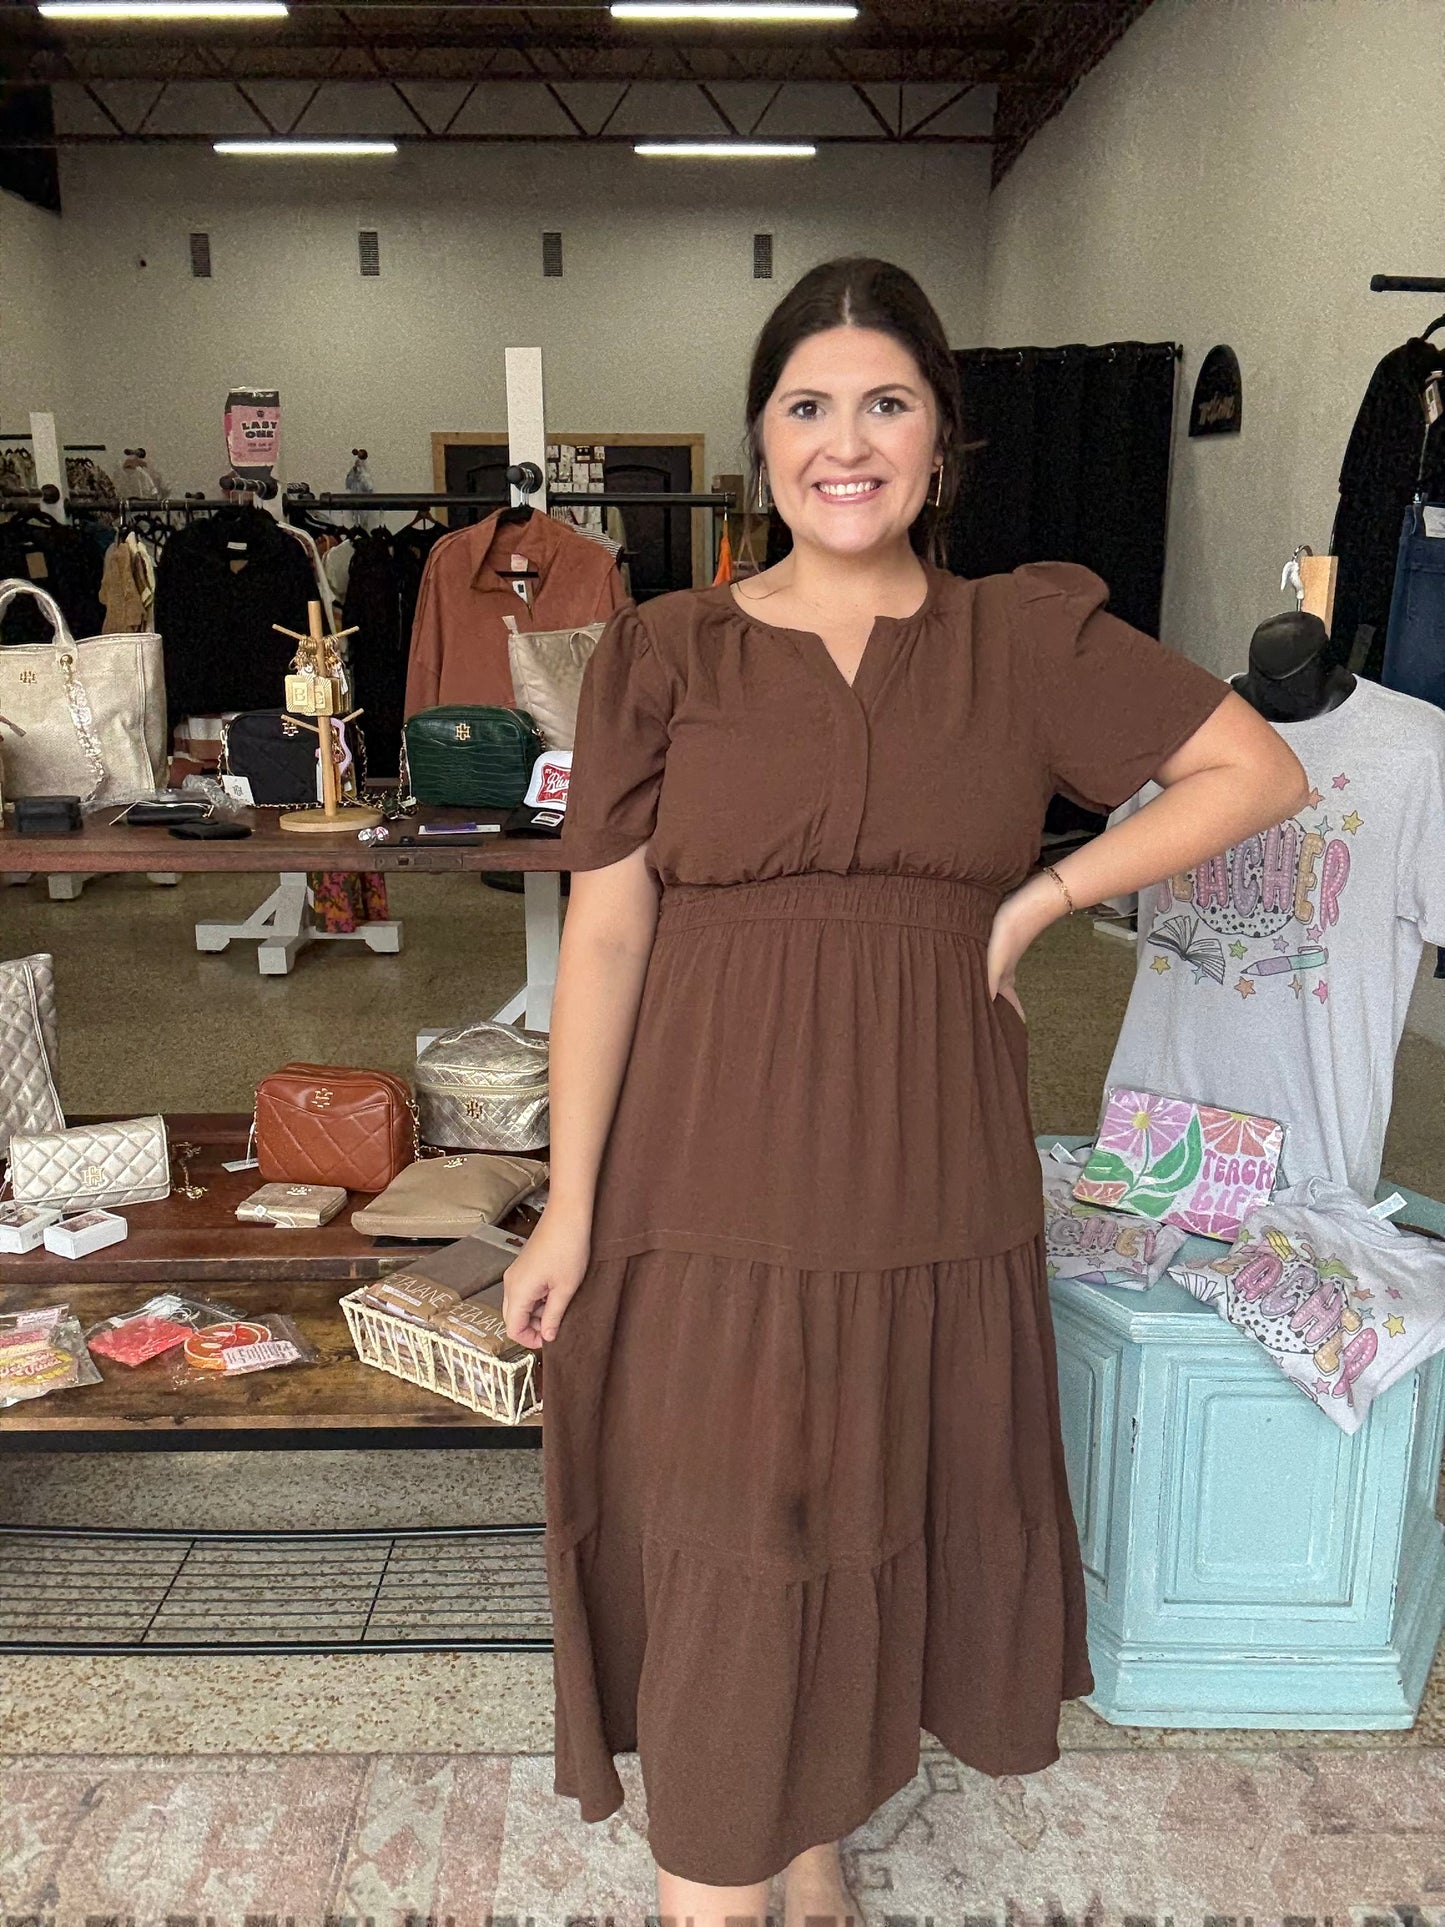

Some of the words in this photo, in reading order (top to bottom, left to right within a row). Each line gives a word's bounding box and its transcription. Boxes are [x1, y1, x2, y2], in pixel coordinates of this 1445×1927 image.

[242, 421, 278, 430] LAST
[245, 431, 274, 439] ONE
[1157, 825, 1350, 931] ACHER
[1203, 1149, 1275, 1190] TEACH
